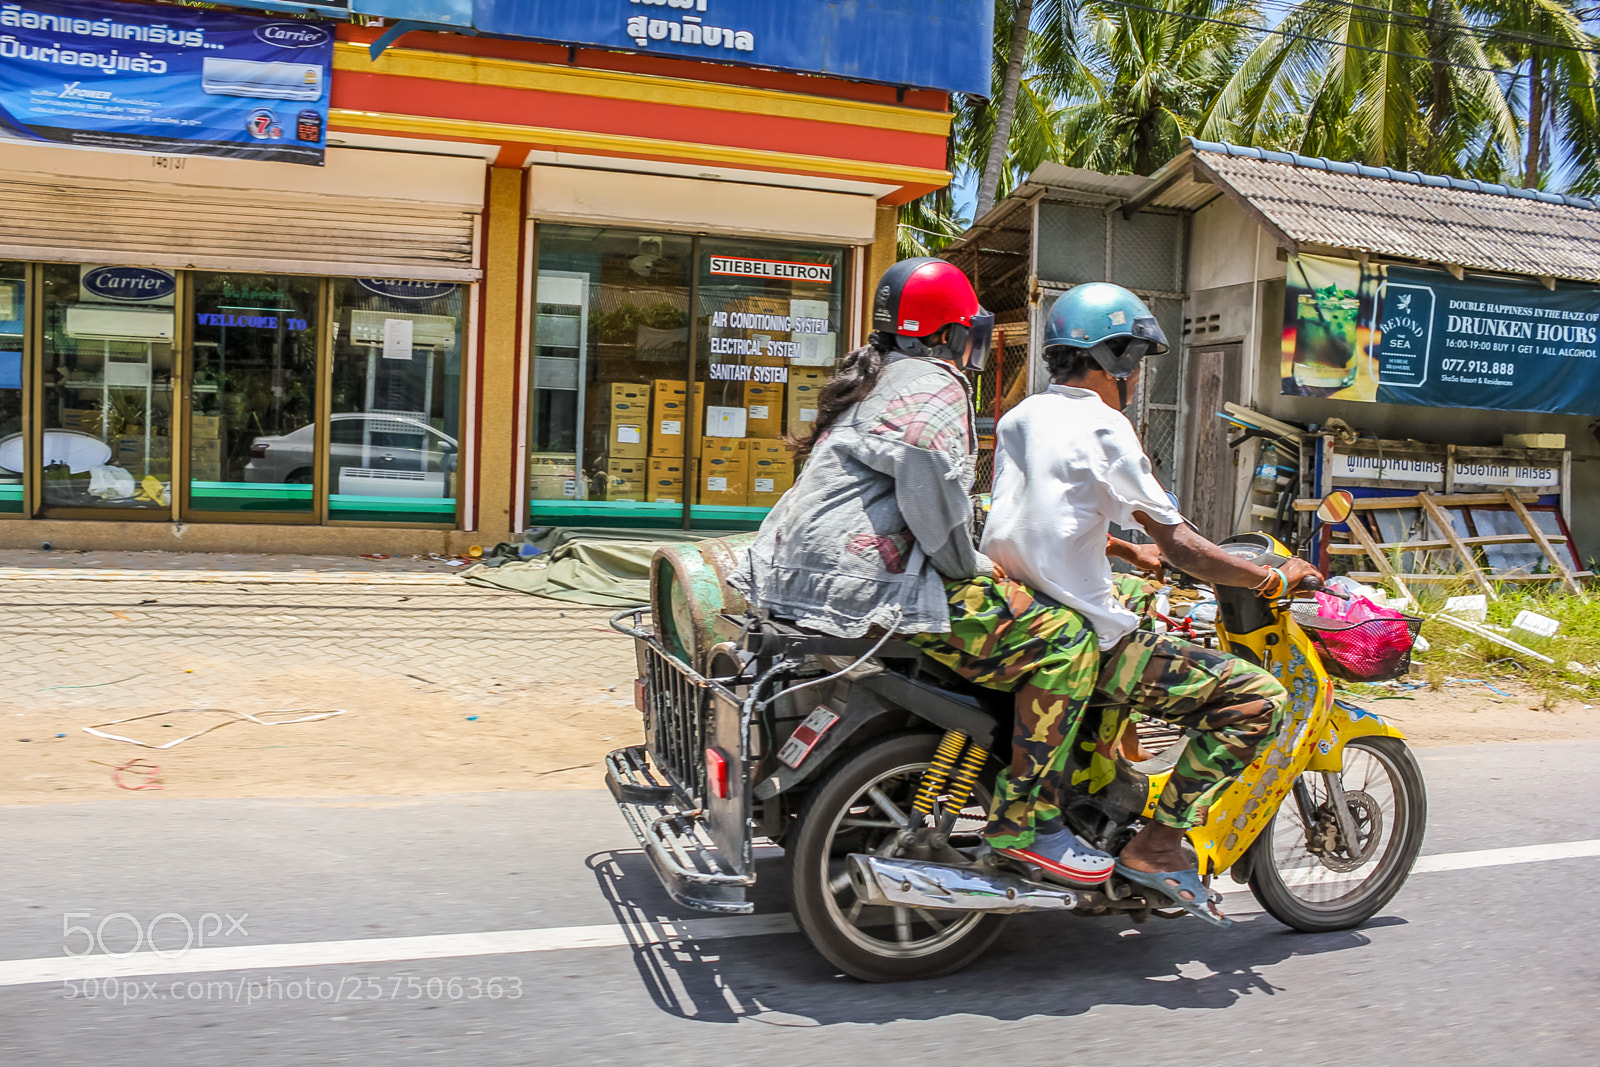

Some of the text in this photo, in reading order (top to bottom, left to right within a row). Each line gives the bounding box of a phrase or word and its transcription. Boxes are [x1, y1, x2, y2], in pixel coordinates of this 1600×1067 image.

[264, 26, 322, 41] Carrier
[627, 15, 754, 51] สุขาภิบาล
[712, 258, 831, 280] STIEBEL ELTRON
[96, 273, 165, 289] Carrier
[1449, 299, 1600, 322] DOUBLE HAPPINESS IN THE HAZE OF
[197, 312, 307, 331] WELLCOME TO
[711, 310, 829, 336] AIR CONDITIONING SYSTEM
[1380, 316, 1424, 338] BEYOND
[1446, 314, 1597, 344] DRUNKEN HOURS
[710, 337, 801, 359] ELECTRICAL SYSTEM
[1389, 339, 1411, 349] SEA
[1445, 338, 1491, 351] 16:00-19:00
[1492, 342, 1510, 352] BUY
[1517, 344, 1534, 354] GET
[1542, 347, 1557, 356] ALL
[1558, 348, 1598, 358] ALCOHOL
[709, 363, 789, 384] SANITARY SYSTEM
[1441, 358, 1515, 376] 077.913.888
